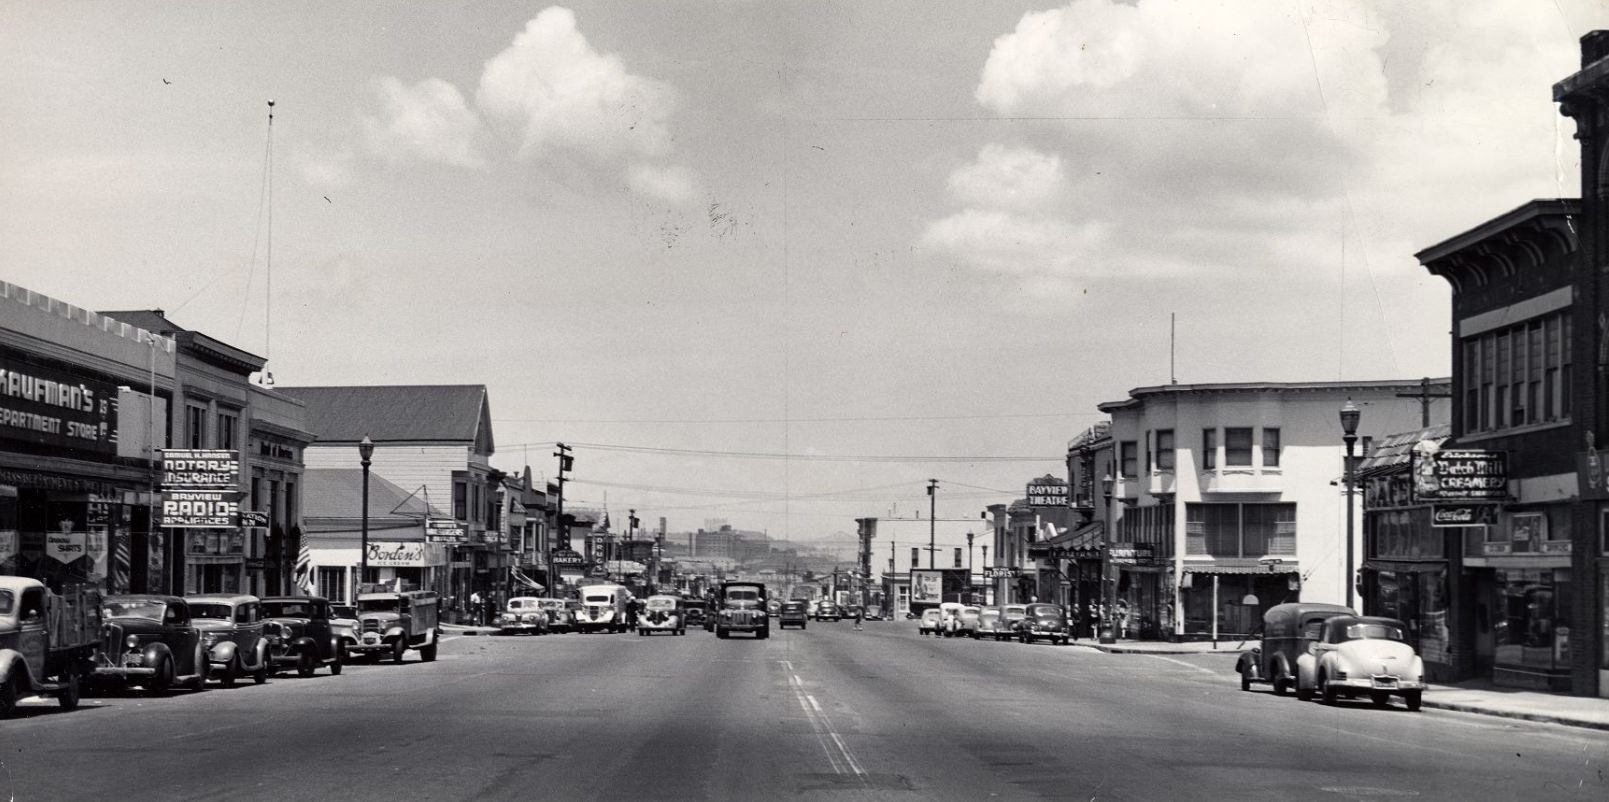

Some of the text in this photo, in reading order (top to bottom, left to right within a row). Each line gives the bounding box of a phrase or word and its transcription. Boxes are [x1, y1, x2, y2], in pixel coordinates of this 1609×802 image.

[66, 421, 98, 440] STORE
[164, 460, 231, 471] NOTARY
[1437, 460, 1503, 475] Dutch Mill
[163, 472, 231, 483] INSURANCE
[1440, 477, 1506, 489] CREAMERY
[1029, 485, 1068, 495] BAYVIEW
[171, 493, 222, 501] BAYVIEW
[1029, 496, 1068, 506] THEATRE
[163, 501, 230, 516] RADIO
[163, 517, 229, 525] APPLIANCES
[367, 544, 423, 561] Borden's
[596, 537, 604, 572] DRUGS
